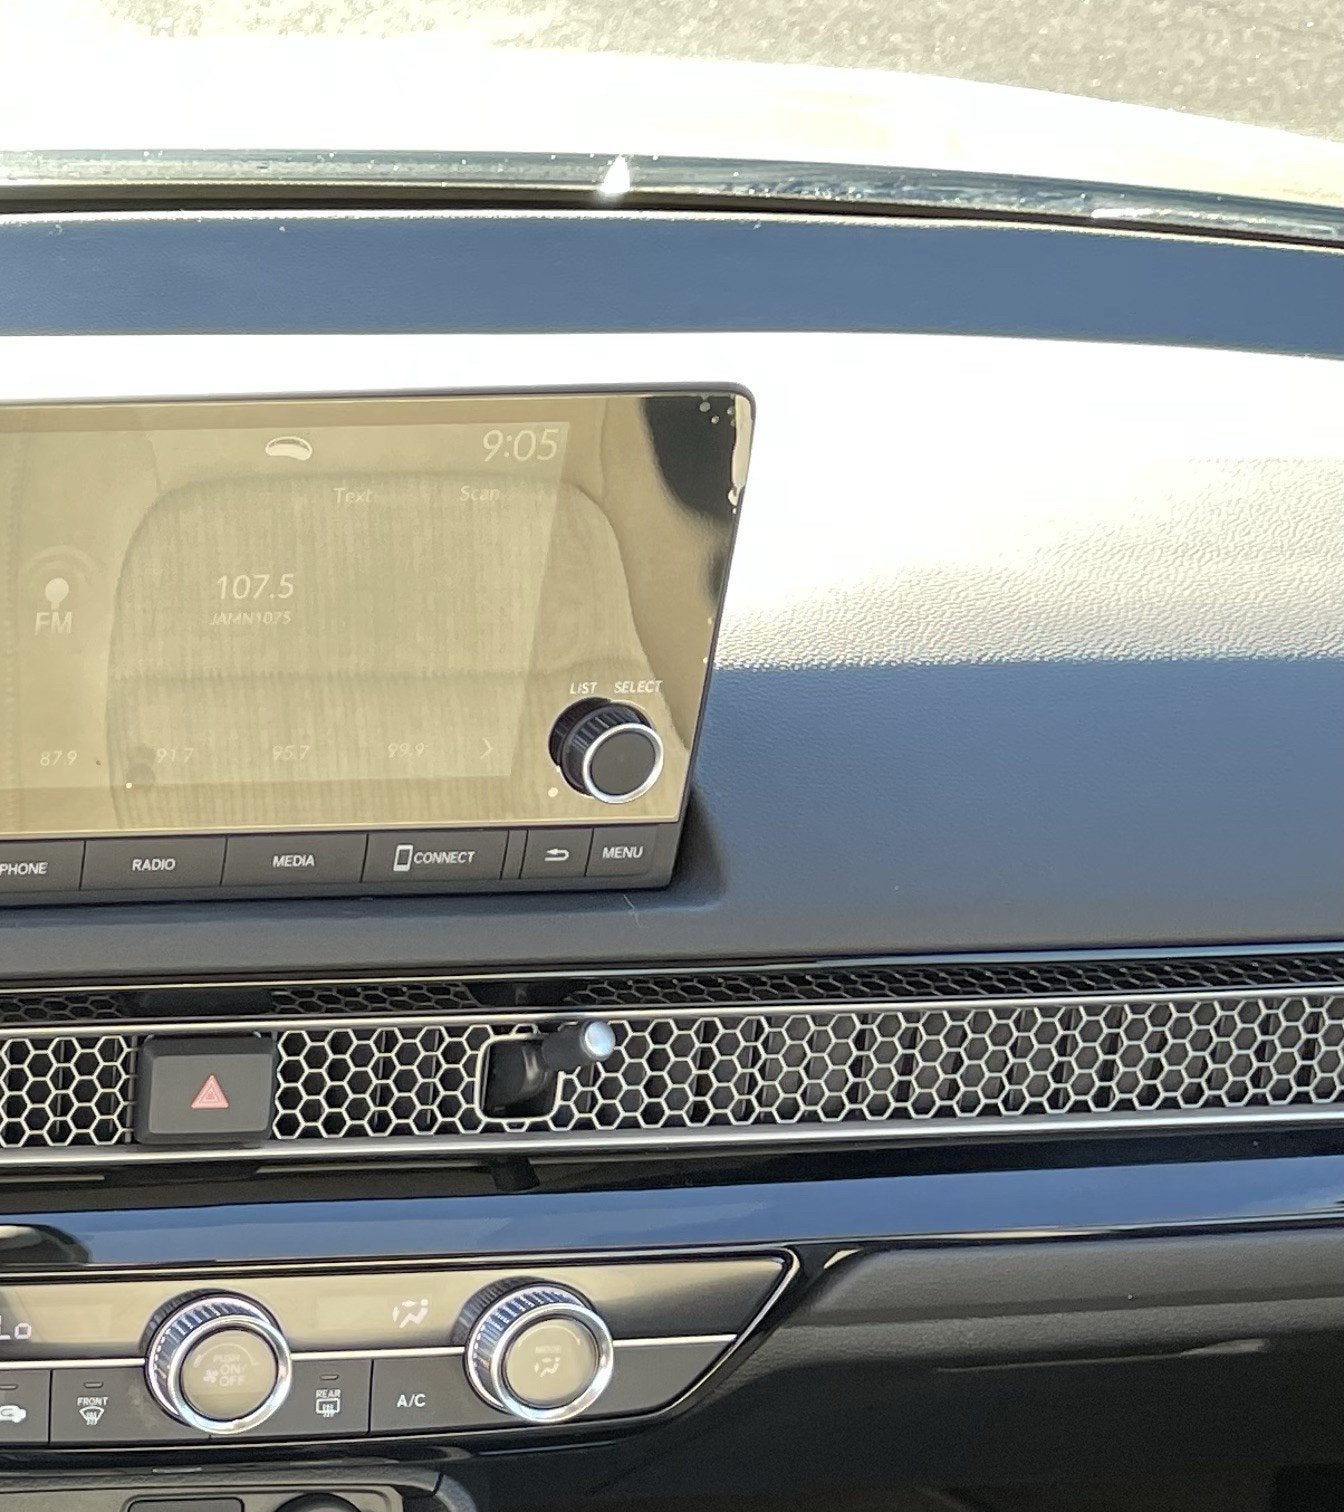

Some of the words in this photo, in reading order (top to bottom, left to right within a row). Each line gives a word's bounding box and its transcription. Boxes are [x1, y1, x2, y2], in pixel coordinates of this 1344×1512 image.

[482, 428, 560, 462] 9:05
[333, 486, 374, 504] Text
[459, 484, 501, 502] Scan
[215, 572, 296, 601] 107.5
[34, 610, 74, 636] FM
[569, 681, 598, 695] LIST
[613, 679, 664, 694] SELECT
[413, 849, 475, 865] CONNECT
[602, 843, 644, 860] MENU
[132, 856, 176, 873] RADIO
[272, 853, 315, 869] MEDIA
[219, 1375, 246, 1388] OFF
[77, 1396, 109, 1406] FRONT
[315, 1389, 342, 1399] REAR
[396, 1393, 427, 1408] A/C
